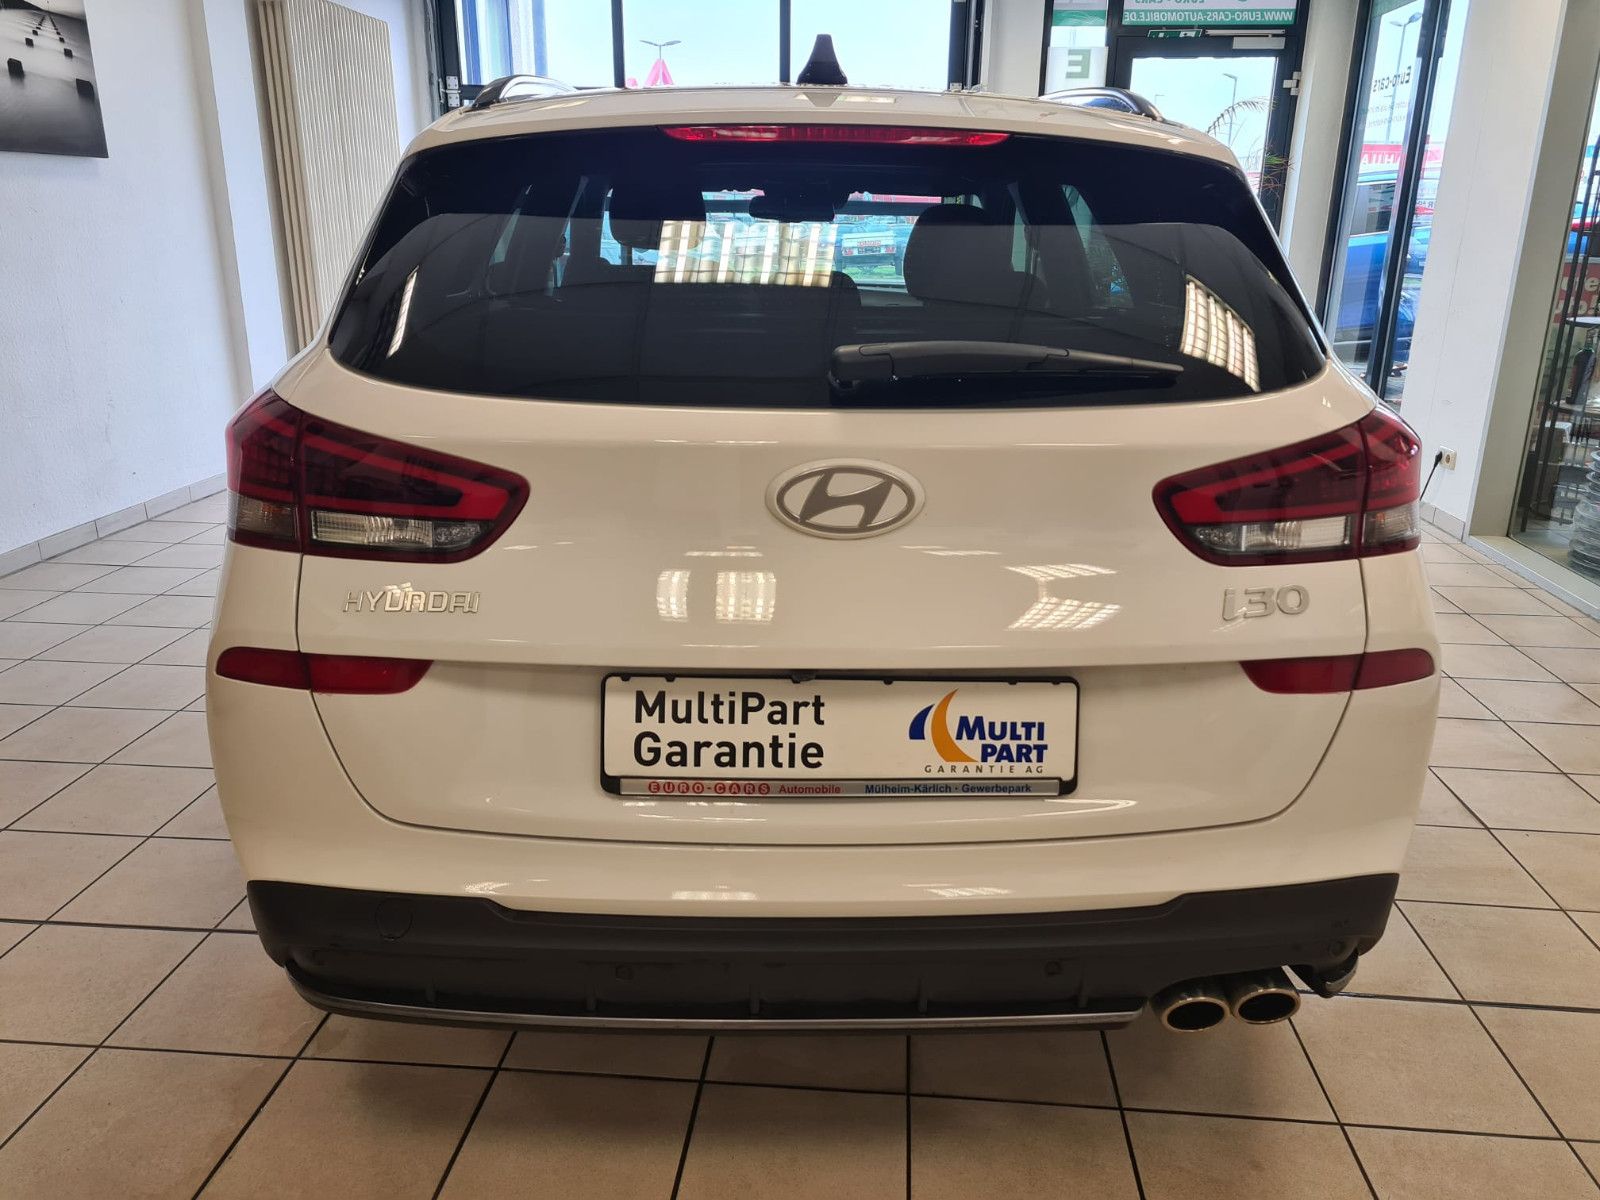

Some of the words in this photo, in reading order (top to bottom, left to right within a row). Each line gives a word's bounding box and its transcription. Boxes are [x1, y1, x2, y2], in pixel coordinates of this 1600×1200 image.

[343, 590, 481, 614] HYUNDAI
[634, 690, 826, 726] MultiPart
[633, 730, 825, 770] Garantie
[980, 743, 1049, 763] PART
[924, 765, 1015, 774] GARANTIE
[1025, 765, 1044, 774] AG
[779, 784, 842, 795] Automobile
[865, 783, 952, 795] Mülheim-Kärlich
[961, 783, 1032, 796] Gewerbepark
